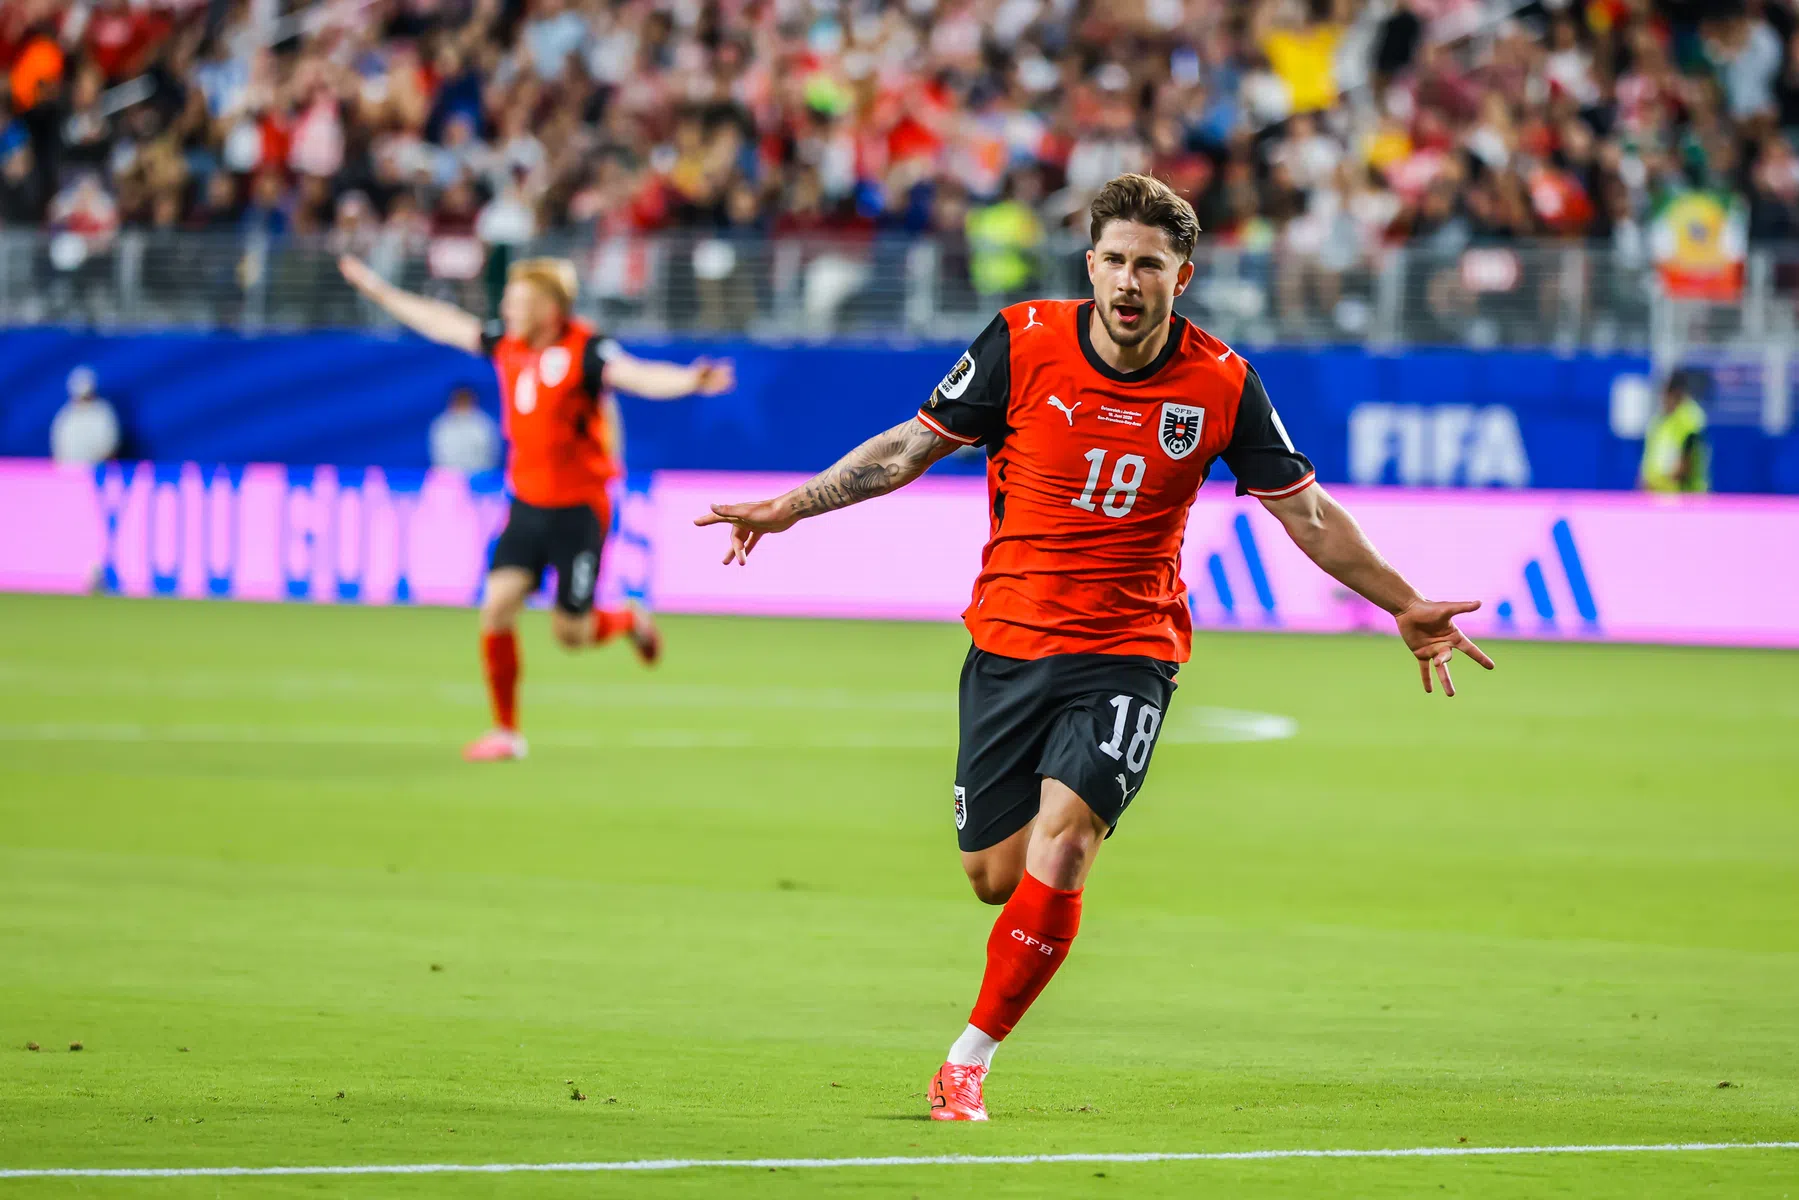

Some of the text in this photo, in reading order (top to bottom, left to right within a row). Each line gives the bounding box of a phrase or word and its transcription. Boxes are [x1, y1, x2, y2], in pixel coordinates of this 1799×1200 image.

[1349, 403, 1530, 487] FIFA
[1071, 448, 1146, 518] 18
[1099, 695, 1161, 774] 18
[1011, 929, 1053, 955] ÖFB
